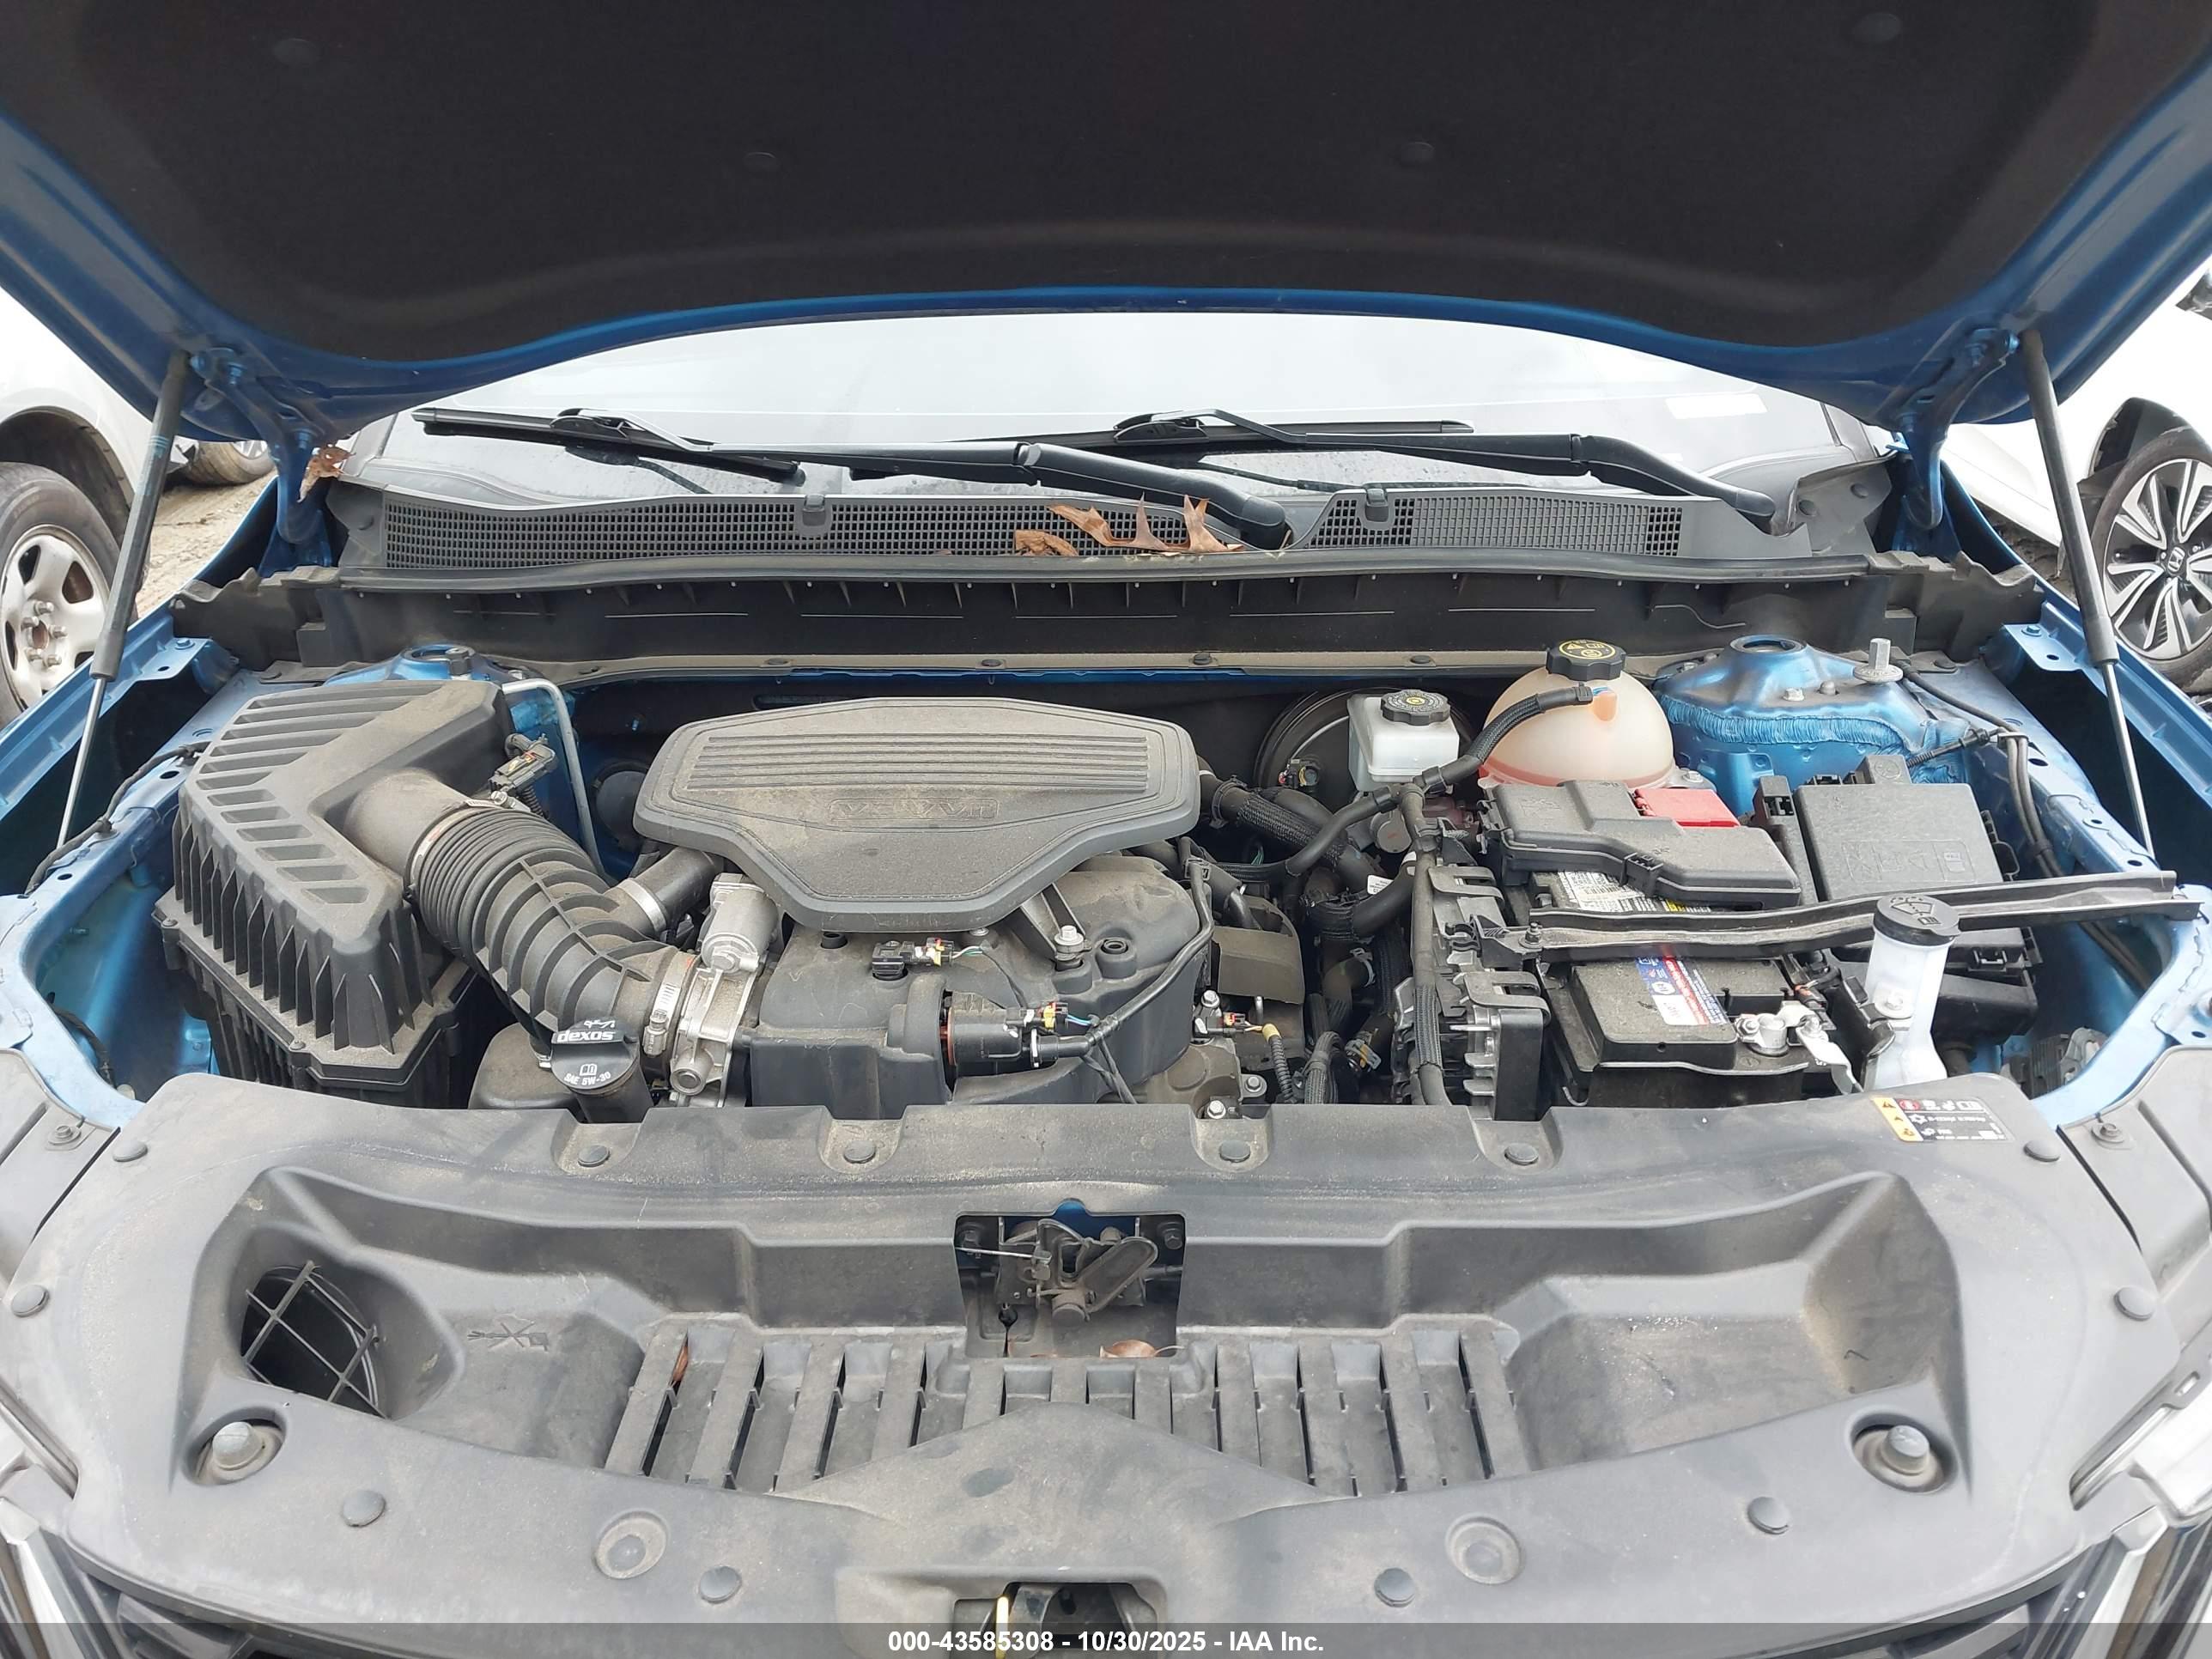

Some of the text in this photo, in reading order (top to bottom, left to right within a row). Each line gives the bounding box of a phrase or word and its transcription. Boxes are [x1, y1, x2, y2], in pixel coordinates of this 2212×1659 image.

[556, 1030, 617, 1042] dexos
[563, 1071, 612, 1086] SAE 5W-30
